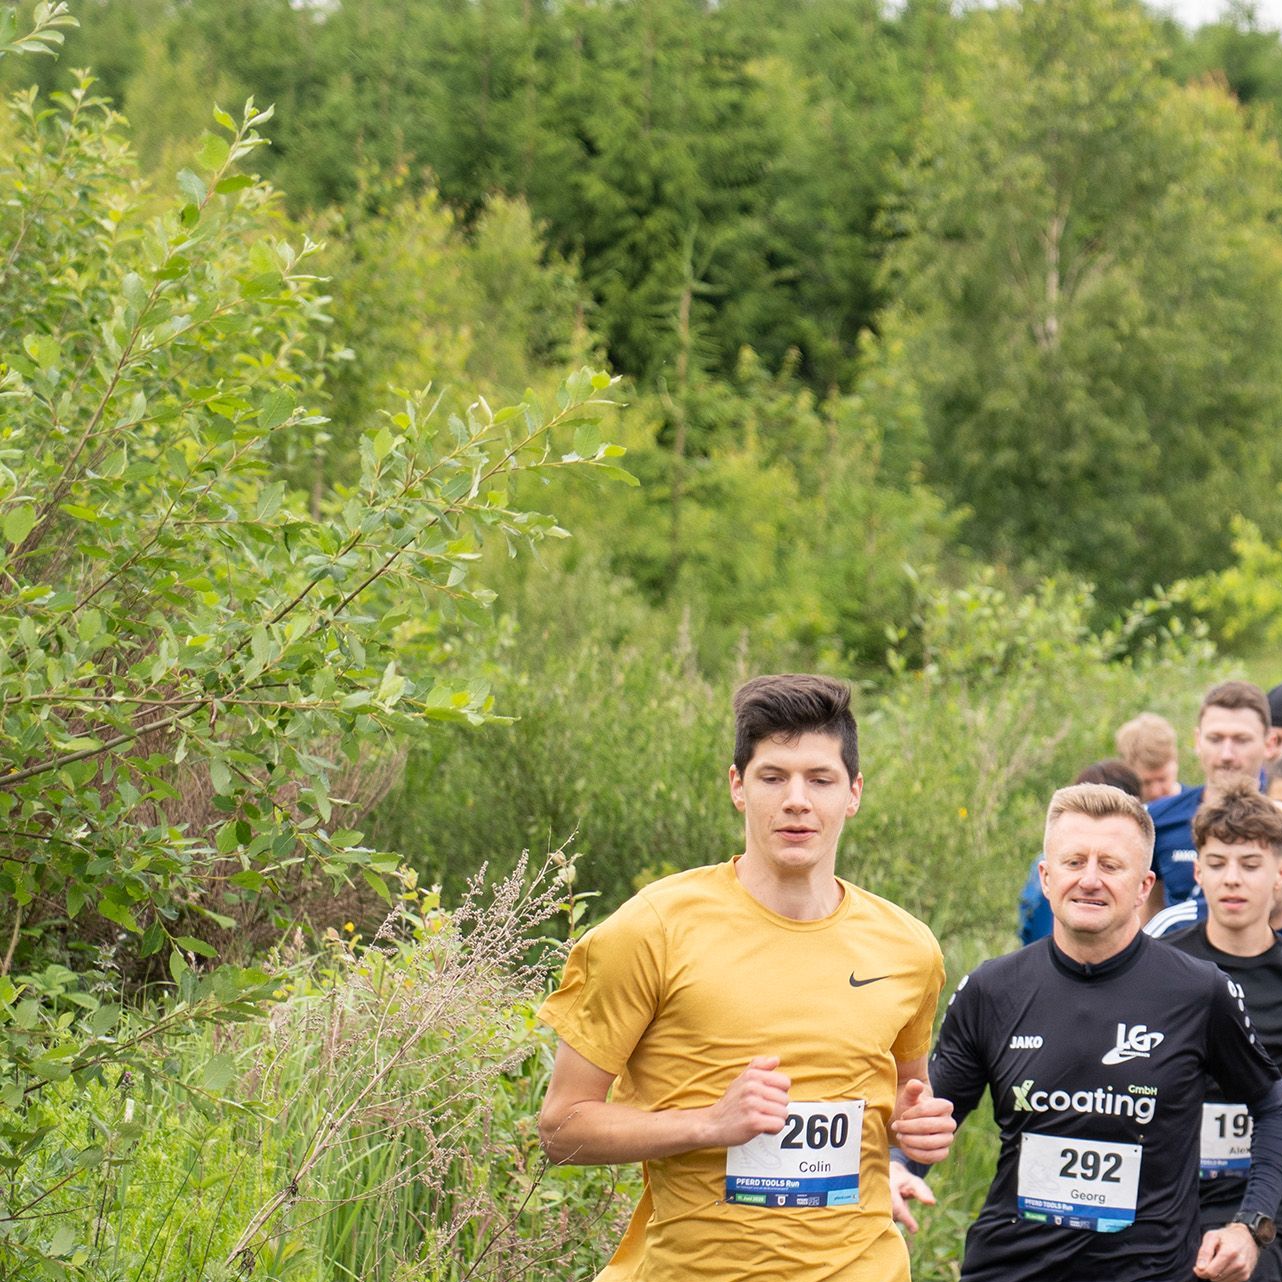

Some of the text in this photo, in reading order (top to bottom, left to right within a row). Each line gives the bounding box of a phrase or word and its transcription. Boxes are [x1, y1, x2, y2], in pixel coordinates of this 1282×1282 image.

[1009, 1035, 1044, 1050] JAKO
[1128, 1084, 1158, 1096] GmbH
[1012, 1080, 1156, 1125] Xcoating
[780, 1113, 849, 1150] 260
[799, 1160, 831, 1173] Colin
[1059, 1148, 1123, 1183] 292
[736, 1178, 800, 1189] PFERD TOOLS Run
[1071, 1189, 1106, 1205] Georg
